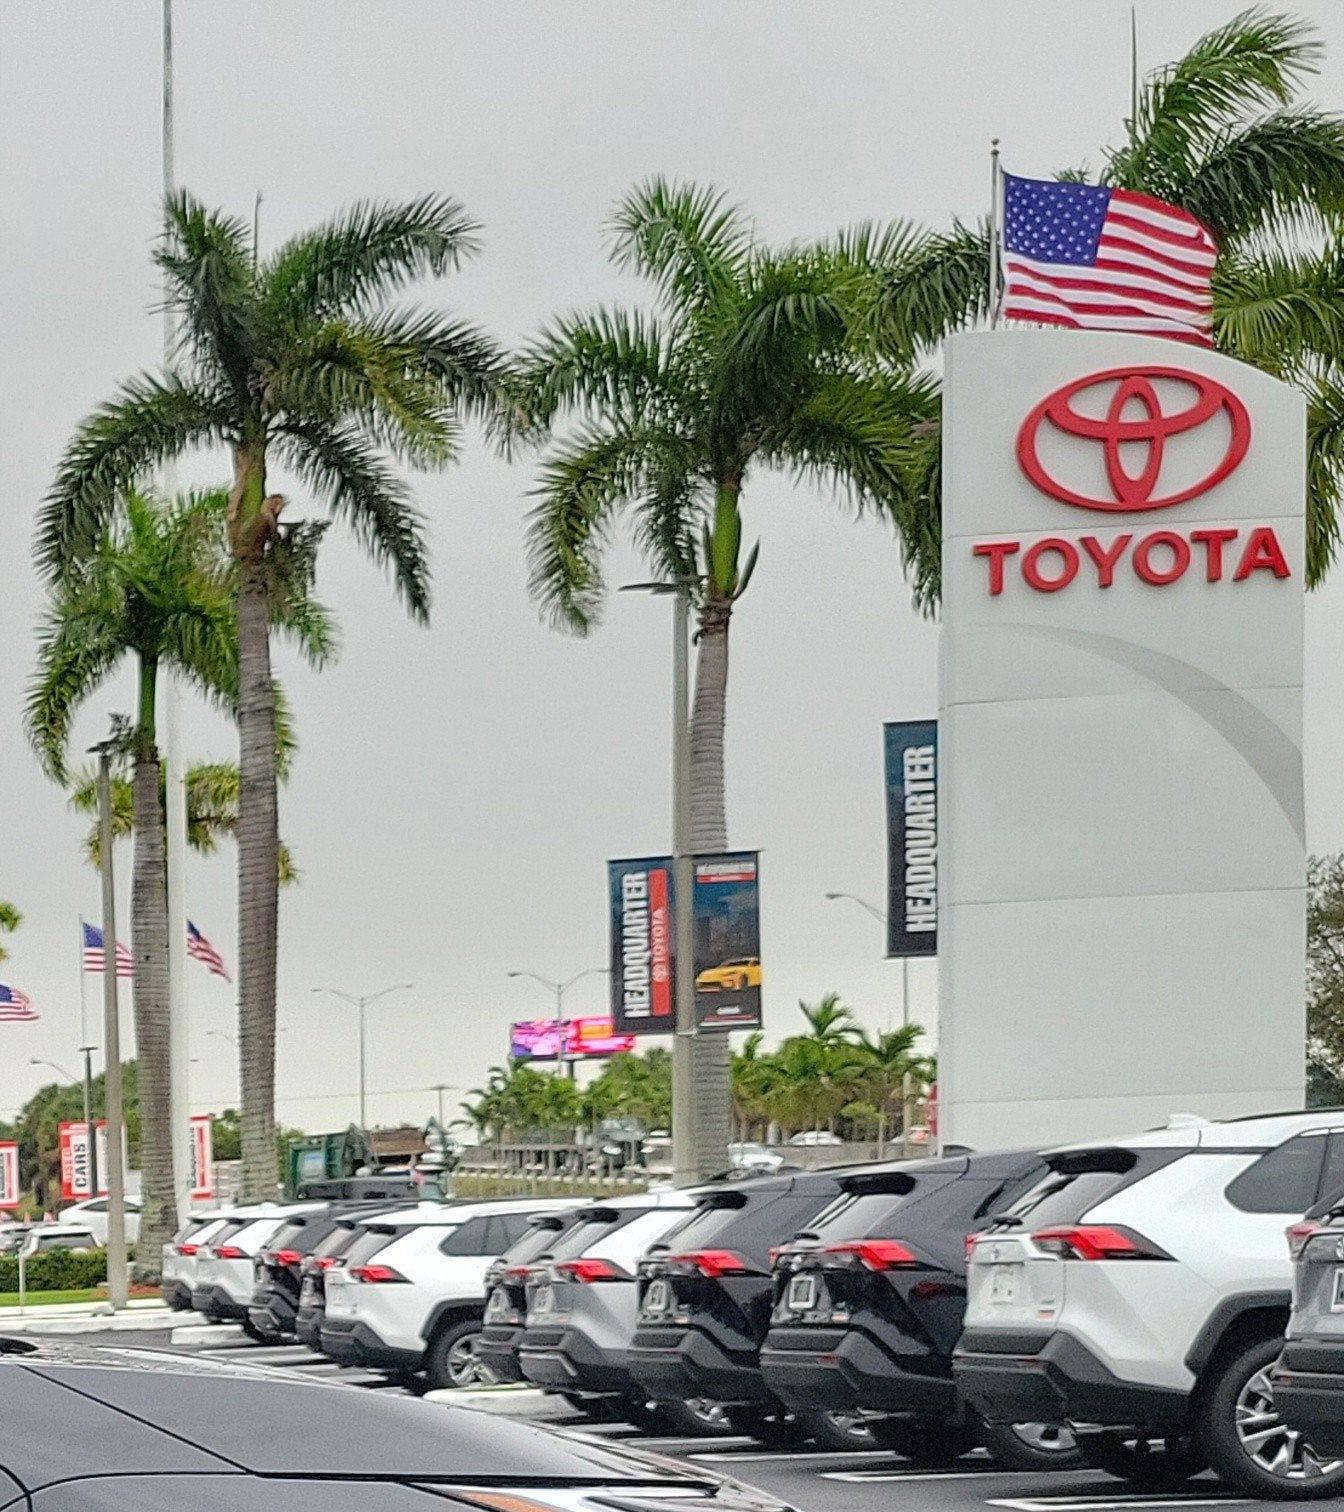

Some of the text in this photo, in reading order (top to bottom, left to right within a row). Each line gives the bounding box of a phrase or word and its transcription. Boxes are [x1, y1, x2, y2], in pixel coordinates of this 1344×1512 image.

[973, 527, 1291, 596] TOYOTA
[903, 744, 938, 933] HEADQUARTER
[622, 871, 651, 1018] HEADQUARTER
[74, 1143, 87, 1188] CARS
